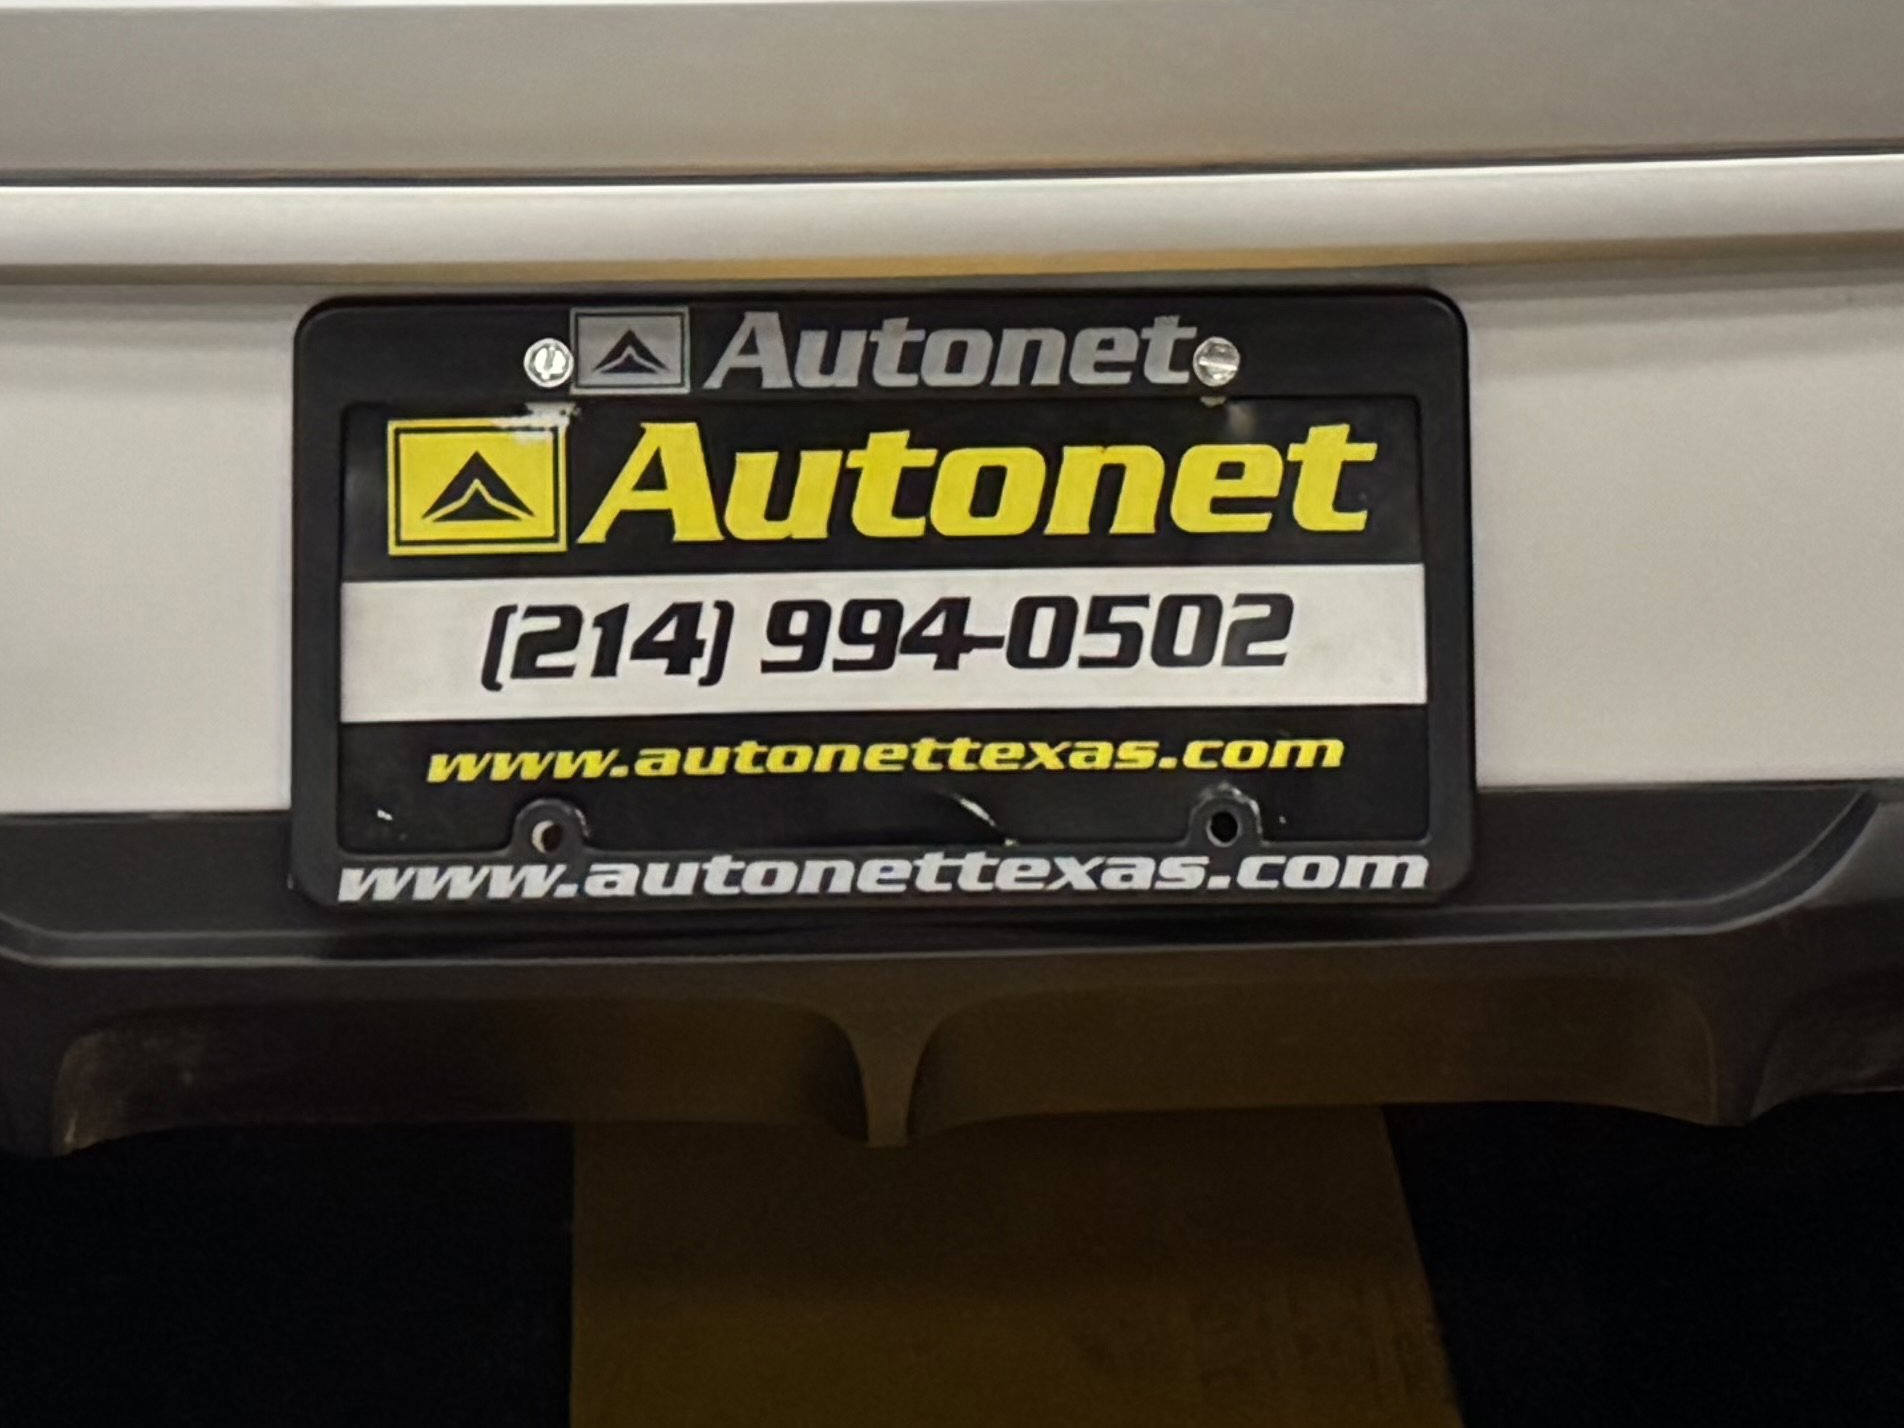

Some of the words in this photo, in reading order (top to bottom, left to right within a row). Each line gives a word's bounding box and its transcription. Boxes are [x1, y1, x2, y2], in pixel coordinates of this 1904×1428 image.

[703, 311, 1197, 390] Autonet
[578, 421, 1377, 543] Autonet
[481, 600, 736, 692] (214)
[760, 594, 1294, 674] 994-0502
[427, 736, 1344, 782] www.autonettexas.com
[338, 852, 1428, 902] www.autonettexas.com
